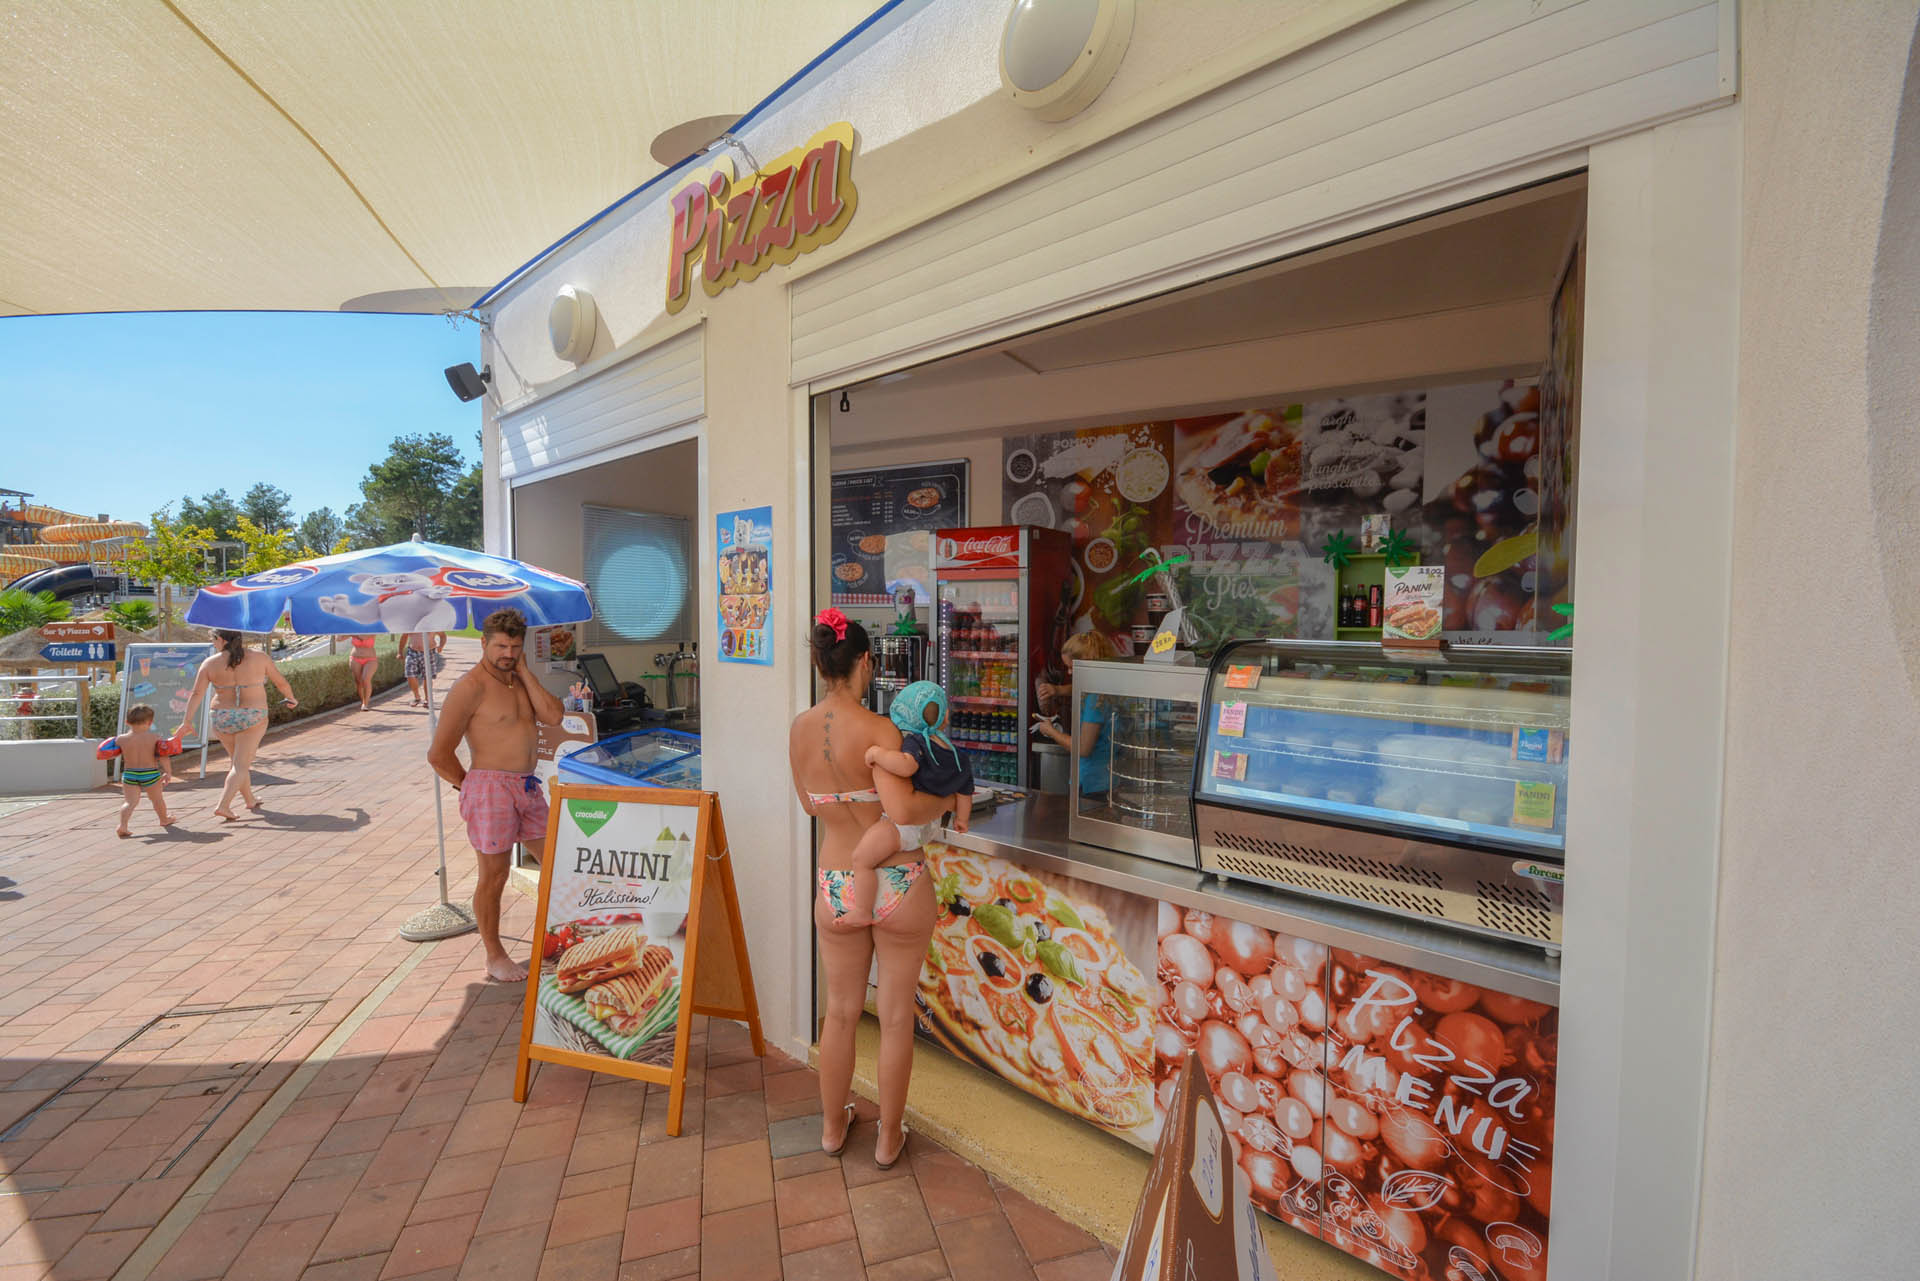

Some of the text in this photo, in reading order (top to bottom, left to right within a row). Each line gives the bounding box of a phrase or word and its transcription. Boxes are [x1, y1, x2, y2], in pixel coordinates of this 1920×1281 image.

[669, 140, 844, 300] Pizza
[1185, 511, 1288, 547] Premium
[1160, 541, 1310, 577] PIZZA
[1203, 573, 1257, 610] Pies
[1394, 582, 1432, 595] PANINI
[67, 628, 90, 636] Piazza
[49, 647, 83, 657] Toilette
[574, 847, 671, 882] PANINI
[577, 886, 660, 908] Italissimo!
[1346, 968, 1532, 1118] Pizza
[1338, 1045, 1508, 1160] MENU
